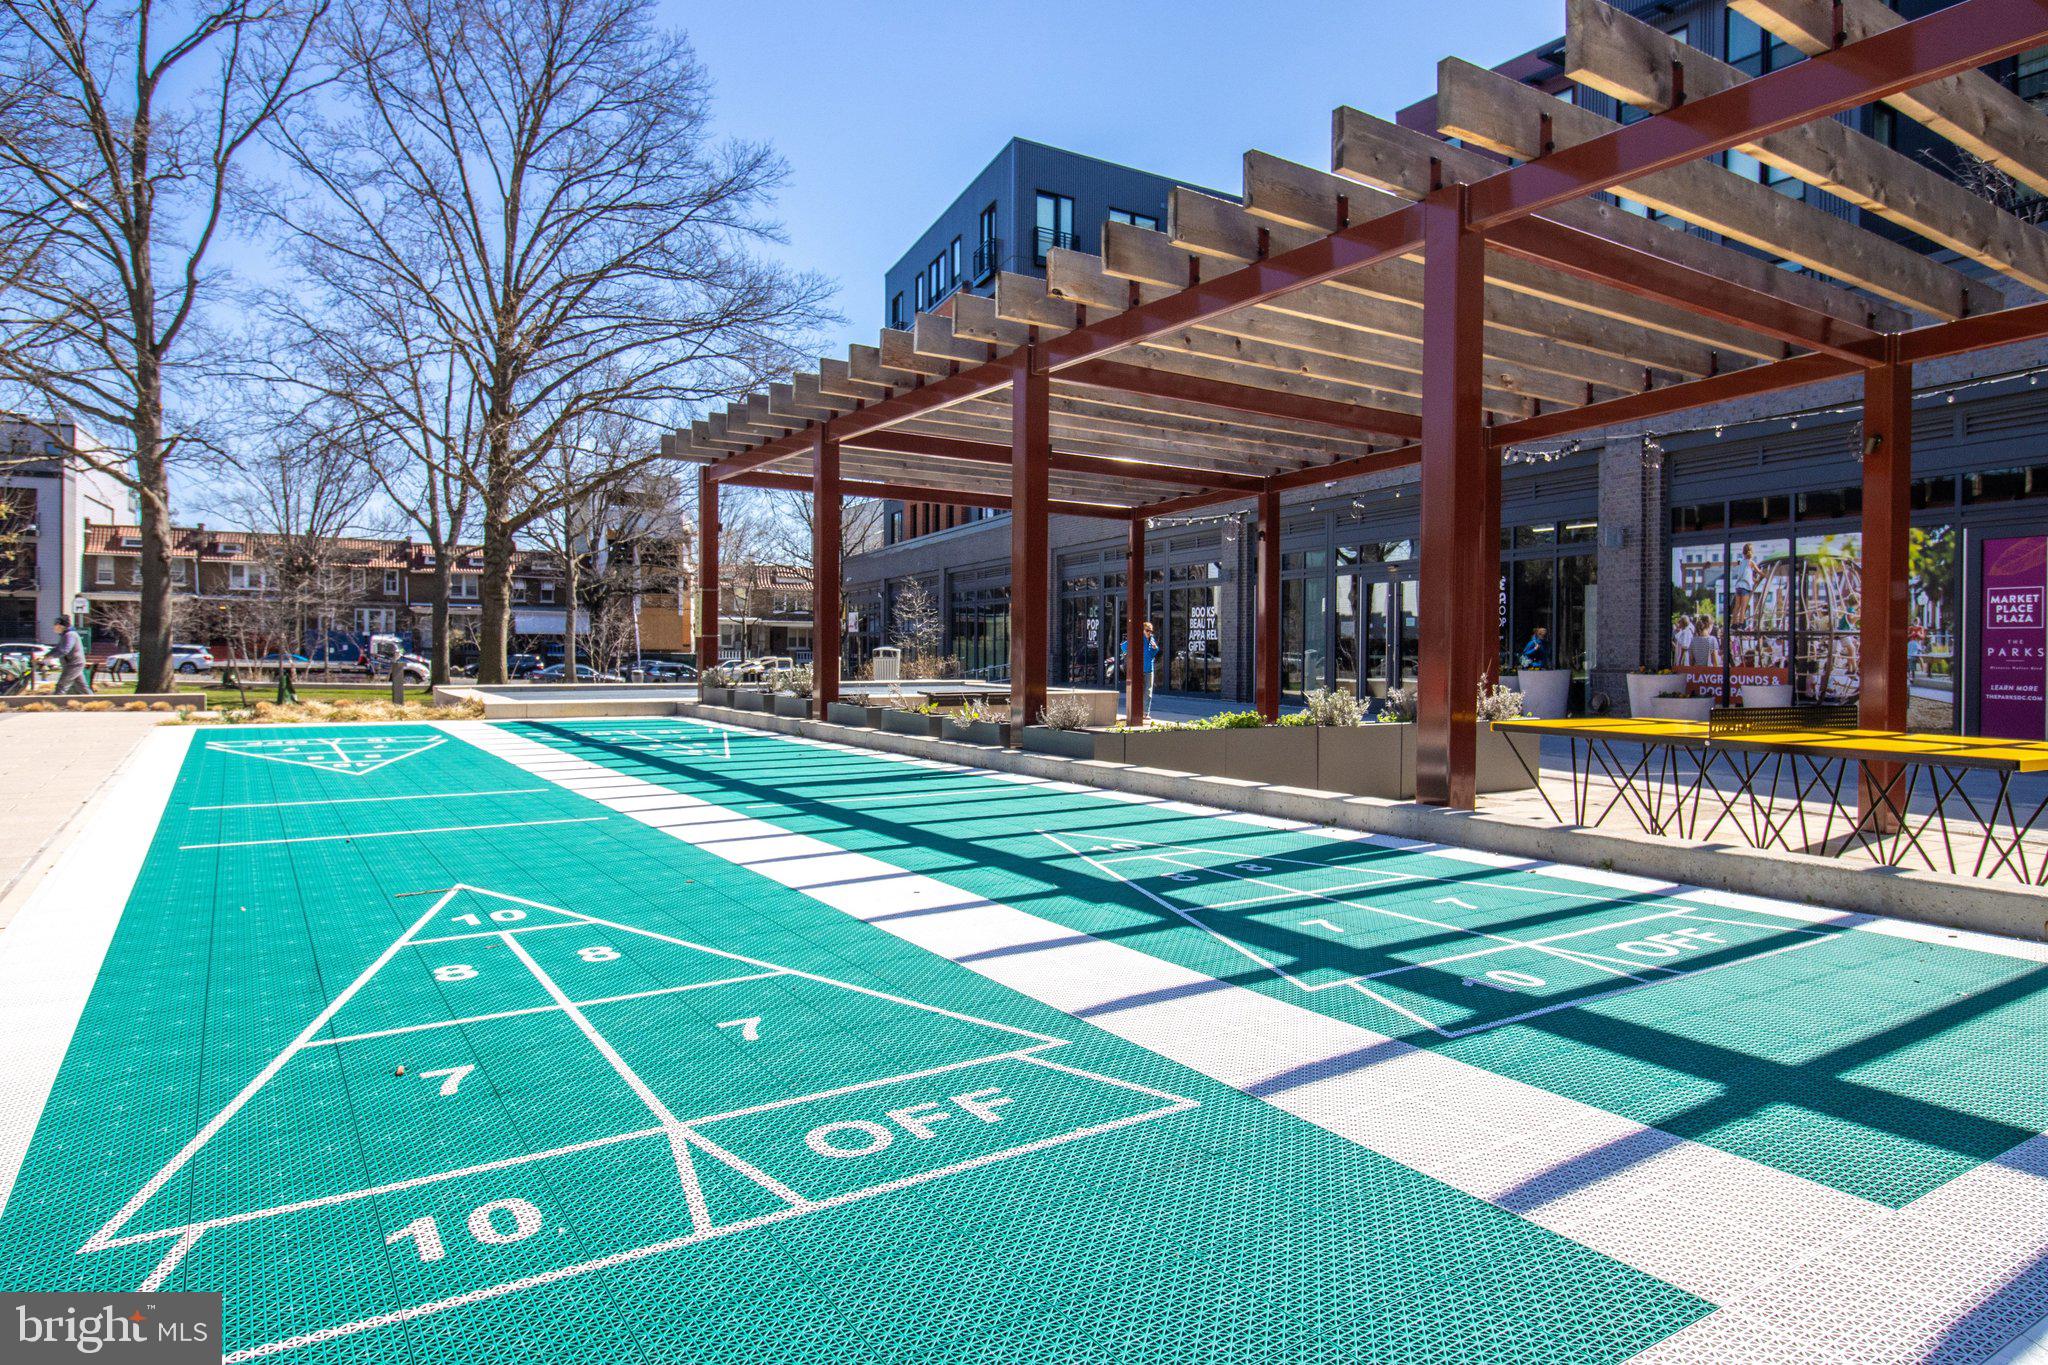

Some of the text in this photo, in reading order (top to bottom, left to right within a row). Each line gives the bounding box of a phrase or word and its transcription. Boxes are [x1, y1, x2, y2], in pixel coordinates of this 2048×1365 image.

[1990, 594, 2040, 604] MARKET
[1191, 606, 1215, 618] BOOKS
[1995, 604, 2034, 613] PLACE
[1190, 618, 1216, 629] BEAUTY
[1995, 614, 2034, 623] PLAZA
[1087, 619, 1099, 630] POP
[1088, 630, 1097, 641] UP
[1189, 629, 1218, 640] APPAREL
[1188, 641, 1206, 652] GIFTS
[1987, 647, 2045, 657] PARKS
[1686, 673, 1780, 686] PLAYGROUNDS &
[1699, 686, 1723, 696] DOG
[452, 908, 527, 927] 10
[1615, 927, 1728, 957] OFF
[576, 945, 622, 962] 8
[433, 964, 480, 982] 8
[717, 1016, 762, 1041] 7
[419, 1064, 475, 1096] 7
[804, 1086, 1015, 1159] OFF
[385, 1197, 543, 1263] 10
